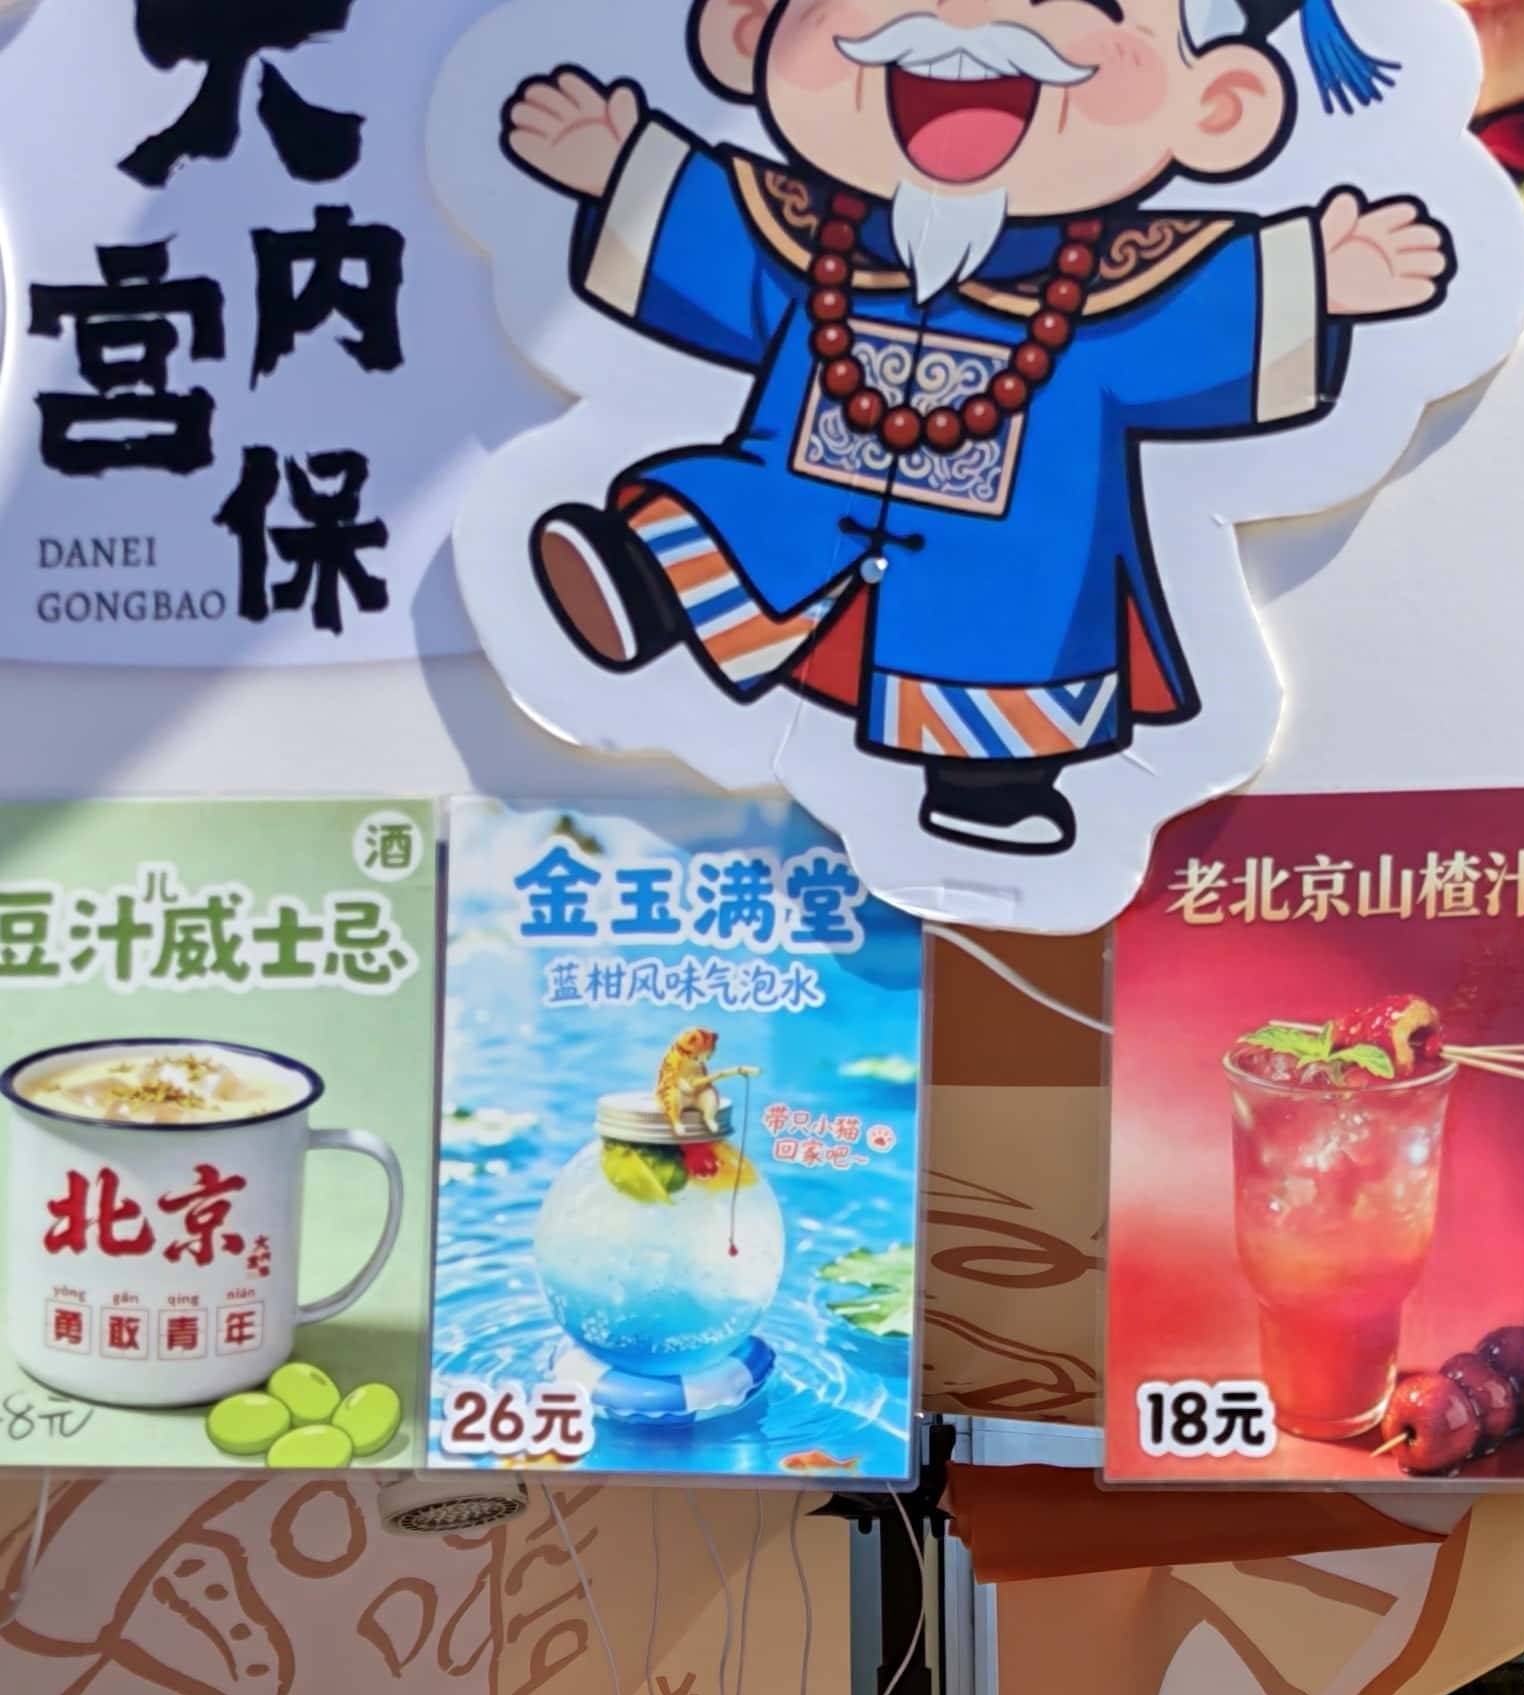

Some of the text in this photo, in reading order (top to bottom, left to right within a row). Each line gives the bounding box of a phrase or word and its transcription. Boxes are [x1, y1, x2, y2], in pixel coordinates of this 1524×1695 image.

[38, 538, 157, 568] DANEI
[37, 590, 226, 623] GONGBAO
[365, 824, 412, 869] 酒
[514, 847, 861, 945] 金玉满堂
[549, 961, 821, 1008] 蓝柑风味气泡水
[763, 1105, 860, 1141] 带只小猫
[44, 1163, 247, 1268] 北京
[0, 1390, 95, 1440] 8元
[451, 1391, 583, 1445] 26元
[1147, 1391, 1266, 1447] 18元
